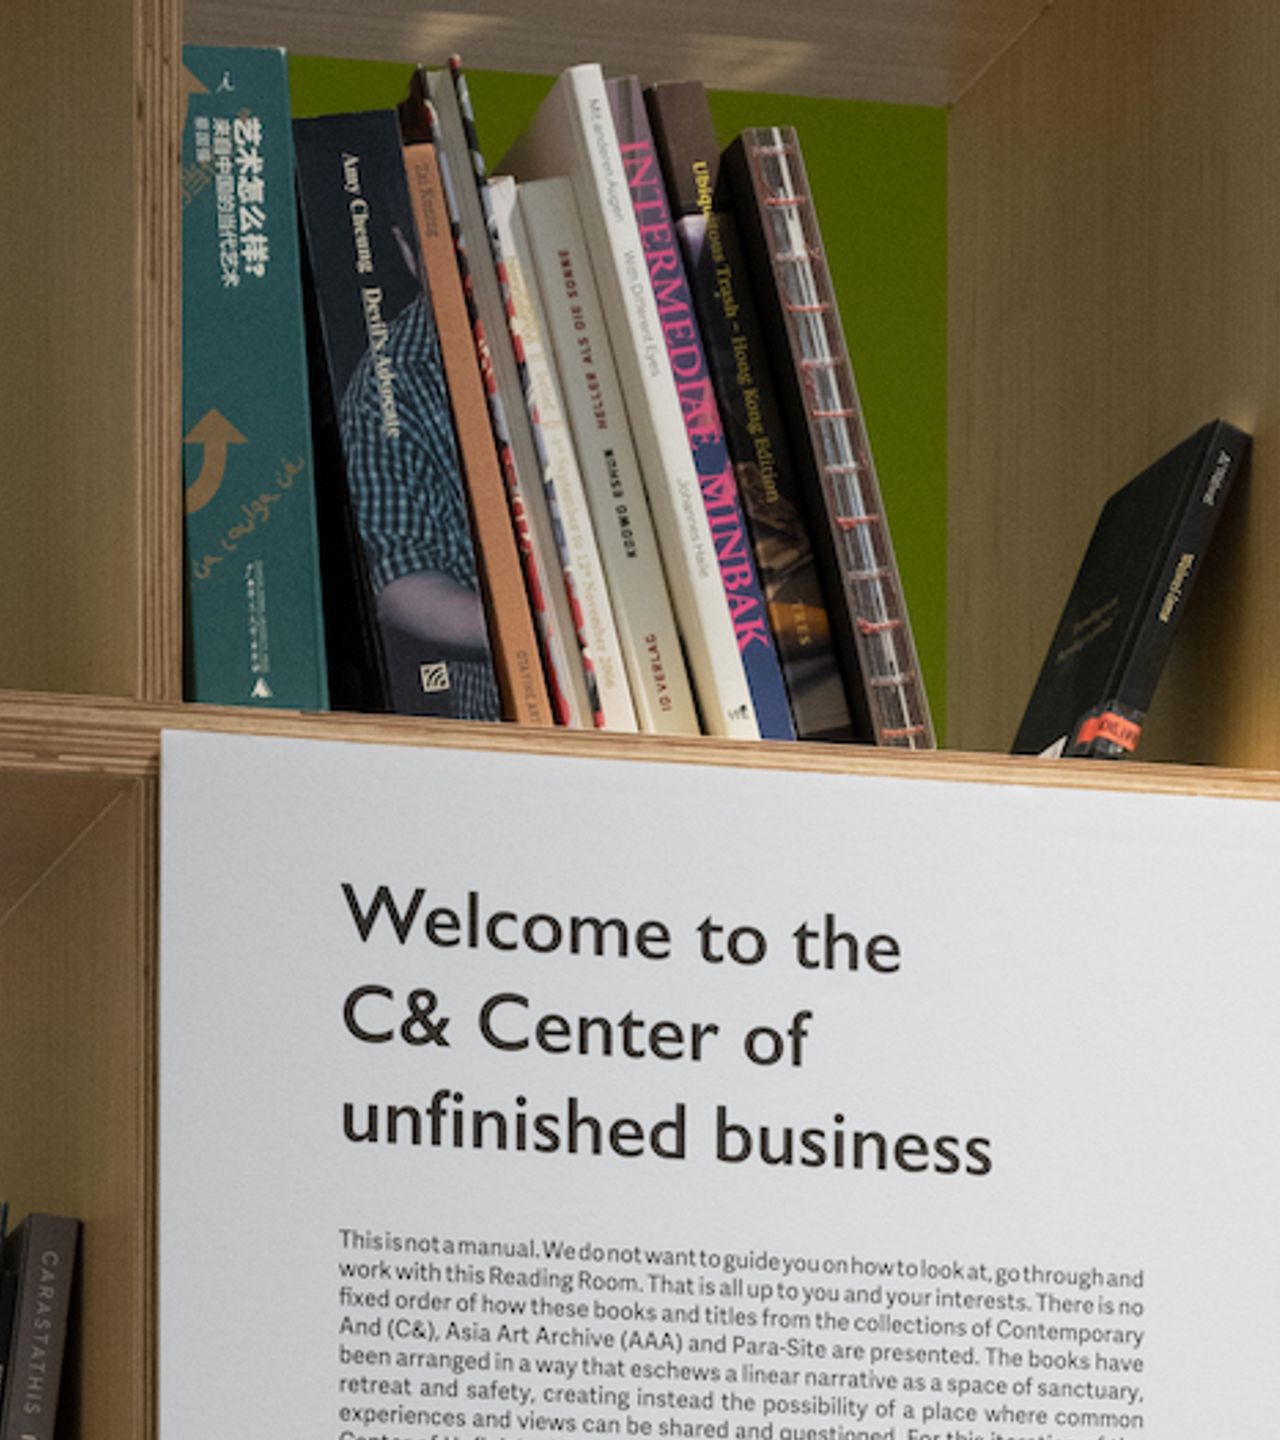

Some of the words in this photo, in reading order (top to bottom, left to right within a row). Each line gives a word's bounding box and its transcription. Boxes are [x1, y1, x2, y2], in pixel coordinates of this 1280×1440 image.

[341, 151, 363, 199] Amy
[693, 161, 724, 263] Ubiquitous
[349, 198, 374, 274] Cheung
[361, 287, 388, 358] Devil's
[717, 263, 738, 319] Trash
[372, 355, 401, 439] Advocate
[732, 334, 754, 388] Hong
[619, 140, 721, 452] INTERMEDIAE
[701, 471, 771, 661] MINBAK
[740, 387, 762, 436] Kong
[751, 435, 780, 503] Edition
[340, 882, 672, 961] Welcome
[695, 915, 768, 966] to
[792, 912, 901, 974] the
[342, 984, 451, 1048] C&
[478, 992, 720, 1062] Center
[743, 1009, 814, 1068] of
[343, 1088, 686, 1161] unfinished
[716, 1104, 993, 1177] business
[23, 1249, 60, 1416] CARASTATHIS
[338, 1315, 382, 1343] And
[386, 1317, 441, 1343] (C&),
[444, 1320, 492, 1343] Asia
[496, 1323, 530, 1345] Art
[535, 1325, 616, 1349] Archive
[620, 1329, 683, 1355] (AAA)
[688, 1333, 727, 1354] and
[732, 1335, 828, 1360] Para-Site
[831, 1344, 866, 1361] are
[869, 1346, 980, 1366] presented.
[984, 1346, 1024, 1368] The
[1028, 1343, 1091, 1371] books
[1095, 1345, 1144, 1374] have
